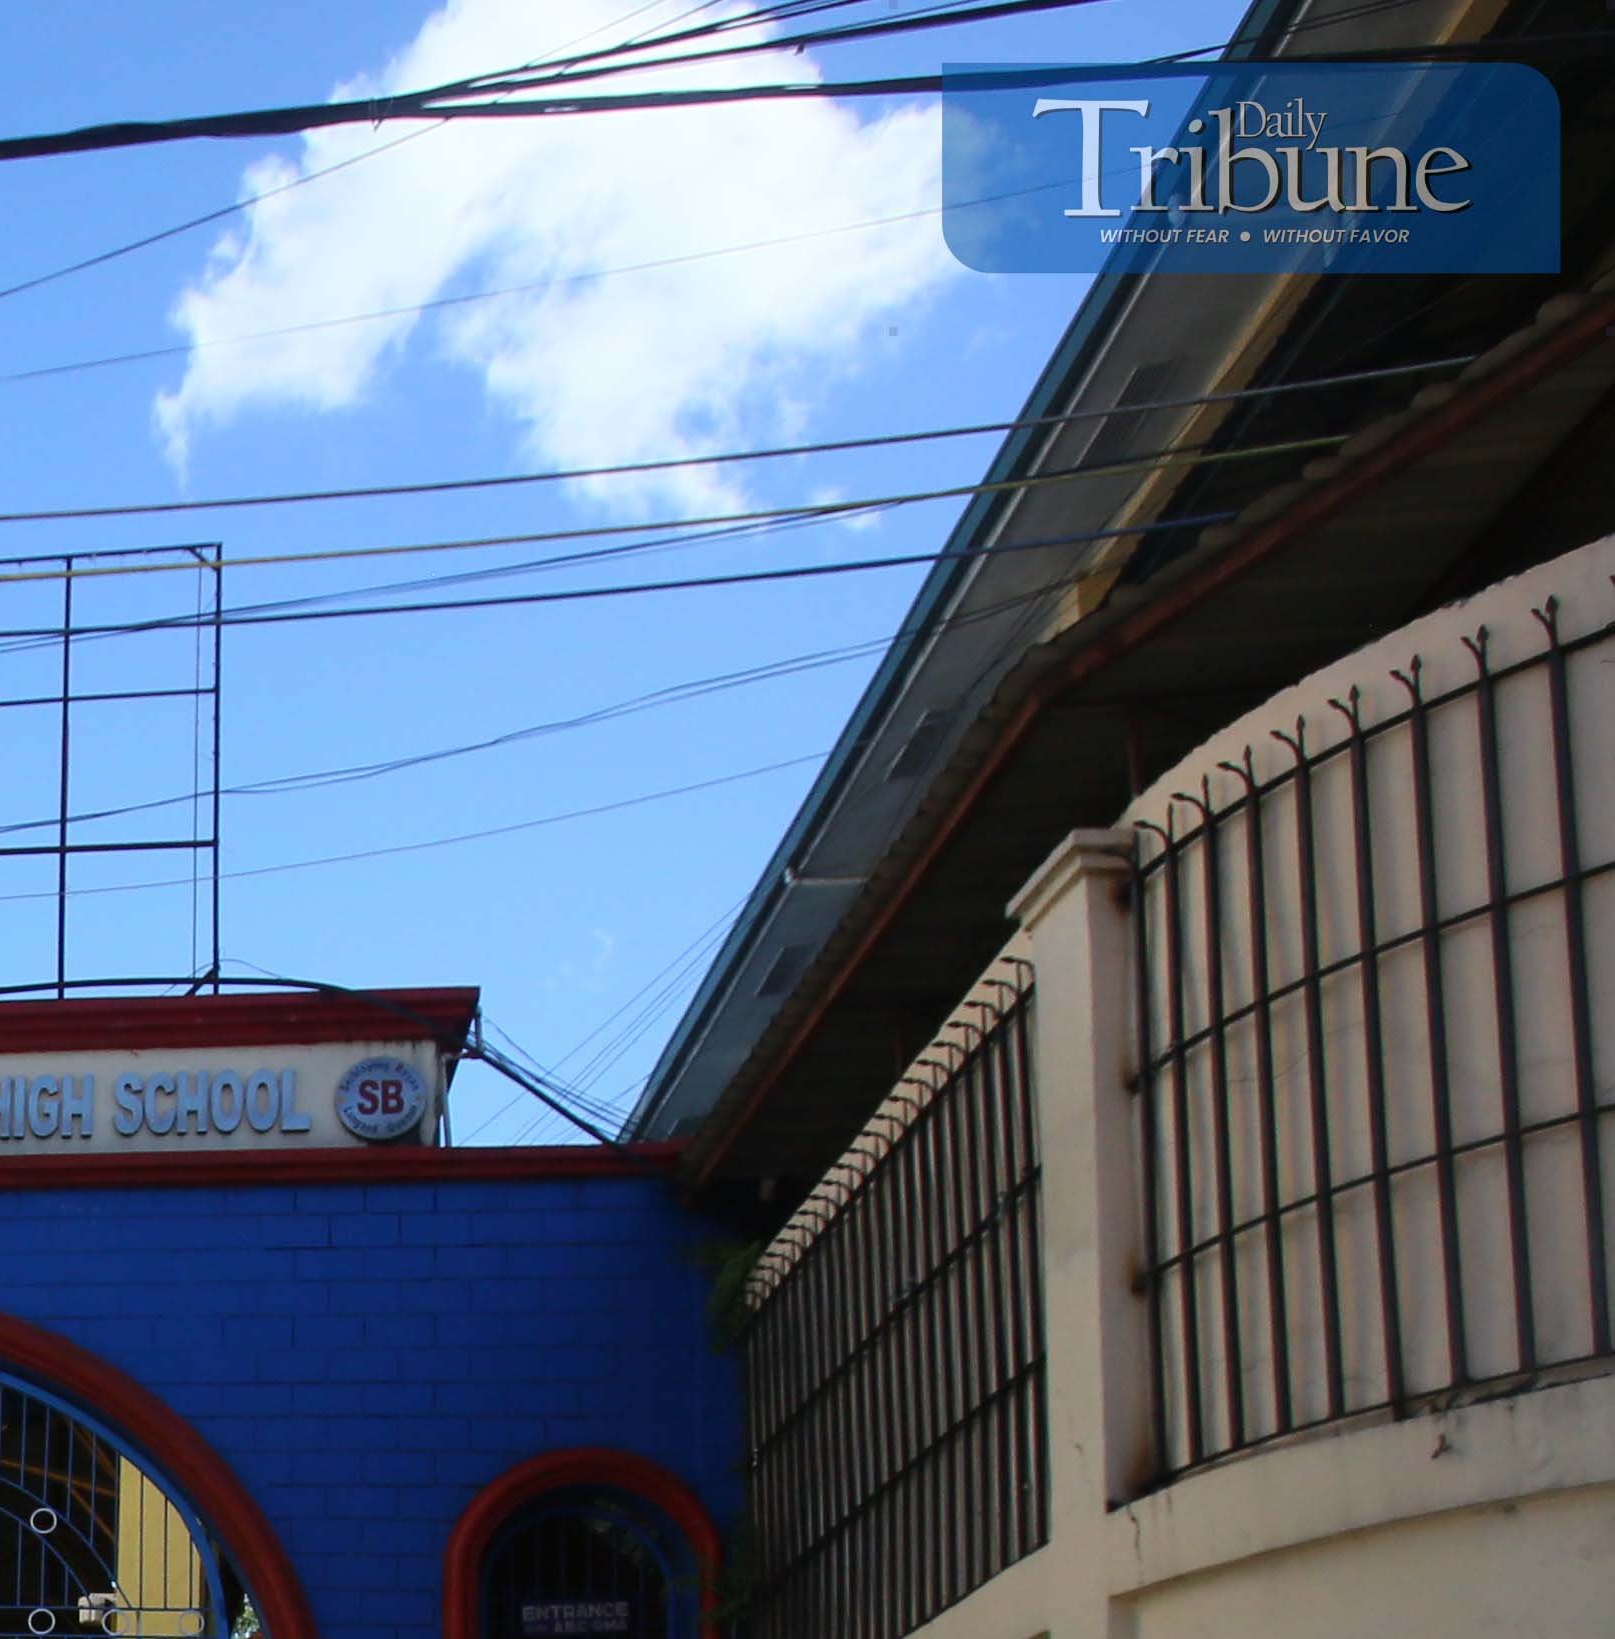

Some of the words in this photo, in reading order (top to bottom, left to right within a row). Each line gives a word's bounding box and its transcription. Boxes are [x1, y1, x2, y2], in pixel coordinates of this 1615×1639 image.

[114, 1067, 312, 1136] SCHOOL
[357, 1079, 404, 1116] SB
[522, 1601, 629, 1621] ENTRANCE
